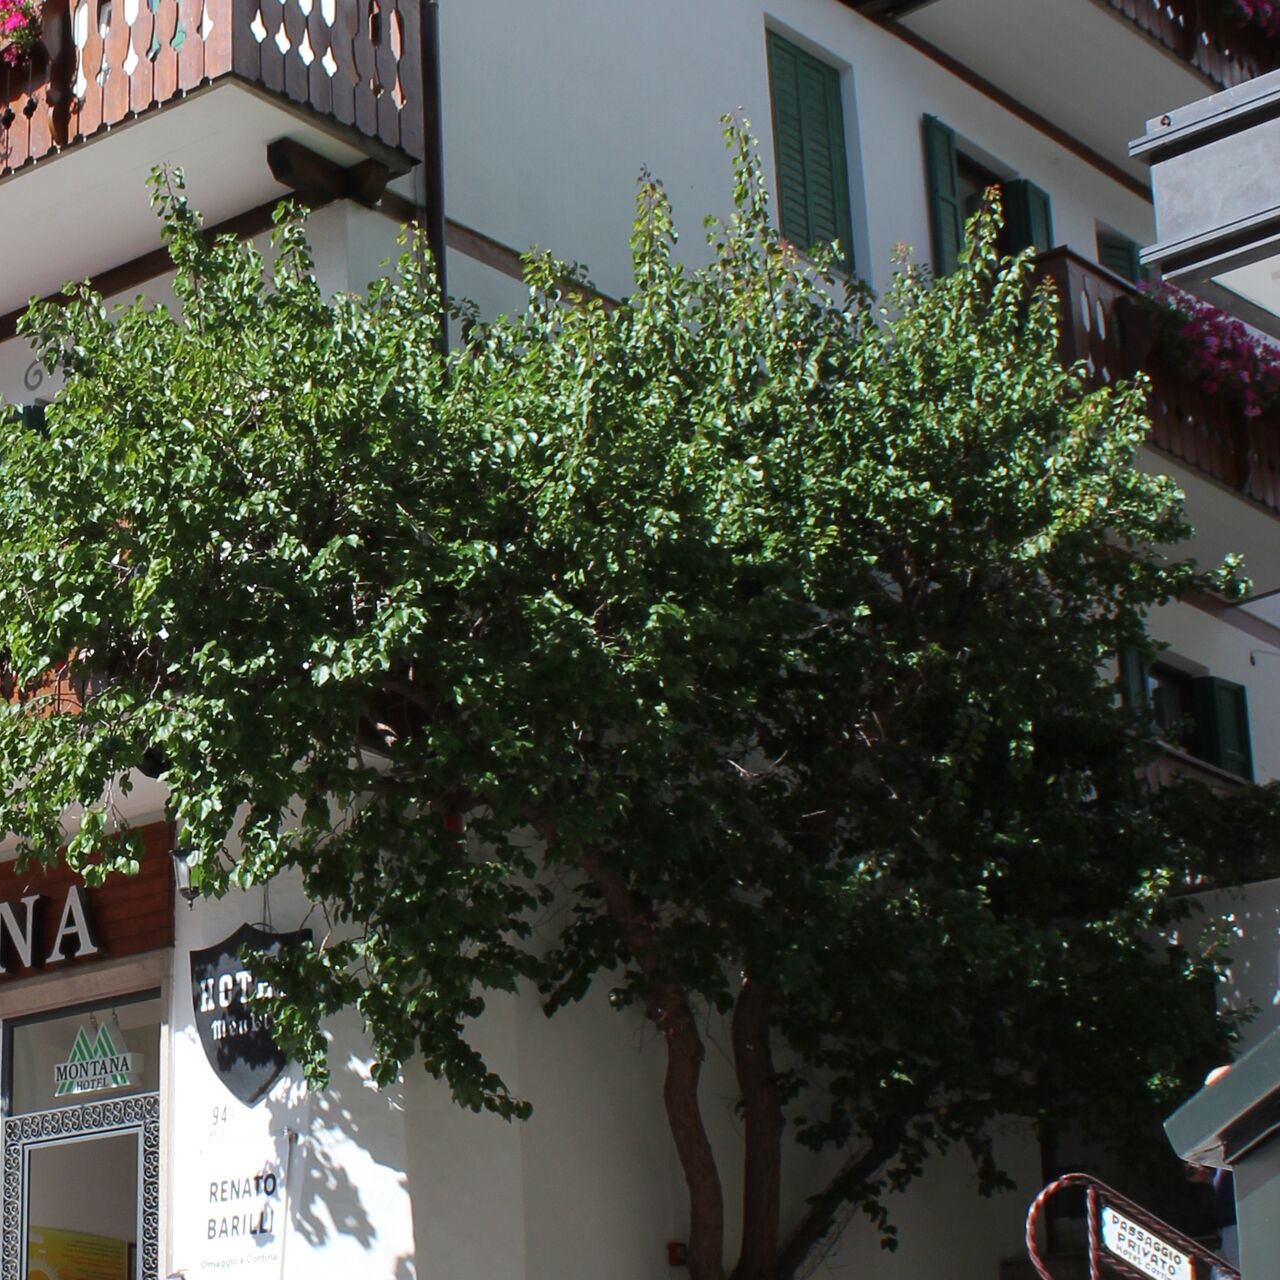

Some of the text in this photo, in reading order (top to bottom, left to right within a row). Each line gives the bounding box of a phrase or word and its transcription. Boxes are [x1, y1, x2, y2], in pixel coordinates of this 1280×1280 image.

[55, 1056, 130, 1082] MONTANA
[76, 1077, 110, 1091] HOTEL
[209, 1173, 277, 1203] RENATO
[207, 1210, 274, 1240] BARILLI
[1112, 1214, 1182, 1265] PASSAGGIO
[1118, 1231, 1176, 1276] PRIVATO
